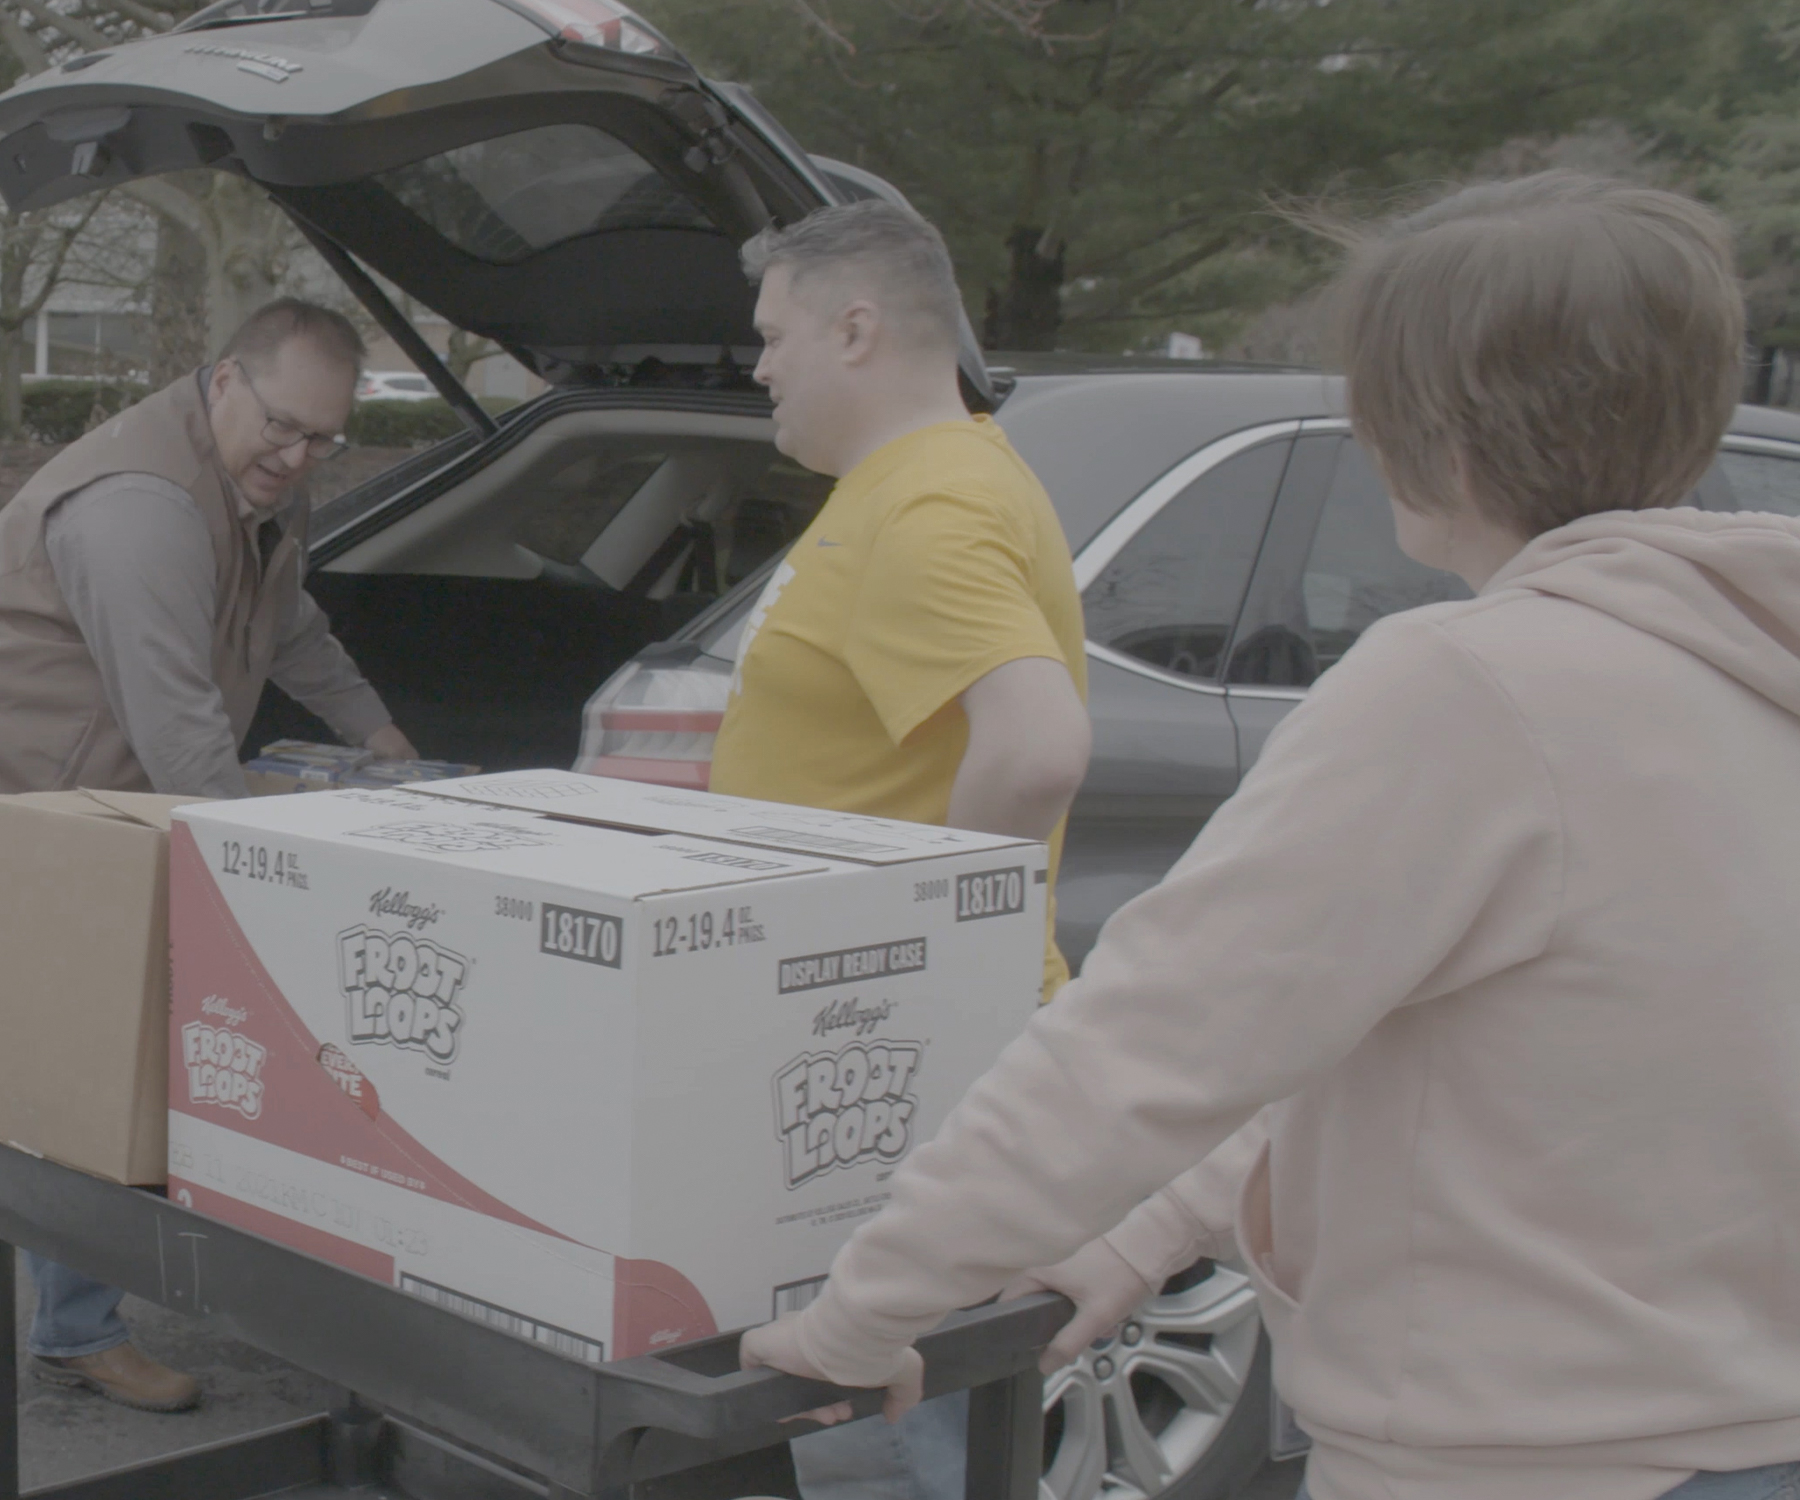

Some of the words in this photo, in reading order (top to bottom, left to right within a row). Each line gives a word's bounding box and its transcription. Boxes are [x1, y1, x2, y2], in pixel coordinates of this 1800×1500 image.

[222, 840, 285, 885] 12-19.4
[369, 886, 441, 932] Kellogg's
[958, 873, 1021, 918] 18170
[546, 908, 616, 962] 18170
[652, 907, 736, 958] 12-19.4
[340, 926, 469, 1006] FROOT
[781, 955, 839, 991] DISPLAY
[842, 947, 887, 981] READY
[889, 940, 925, 973] CASE
[345, 988, 467, 1066] LOOPS
[811, 997, 891, 1038] Kellogg's
[182, 1020, 267, 1079] FROOT
[189, 1062, 265, 1120] LOOPS
[775, 1042, 922, 1138] FROOT
[786, 1098, 919, 1188] LOOPS
